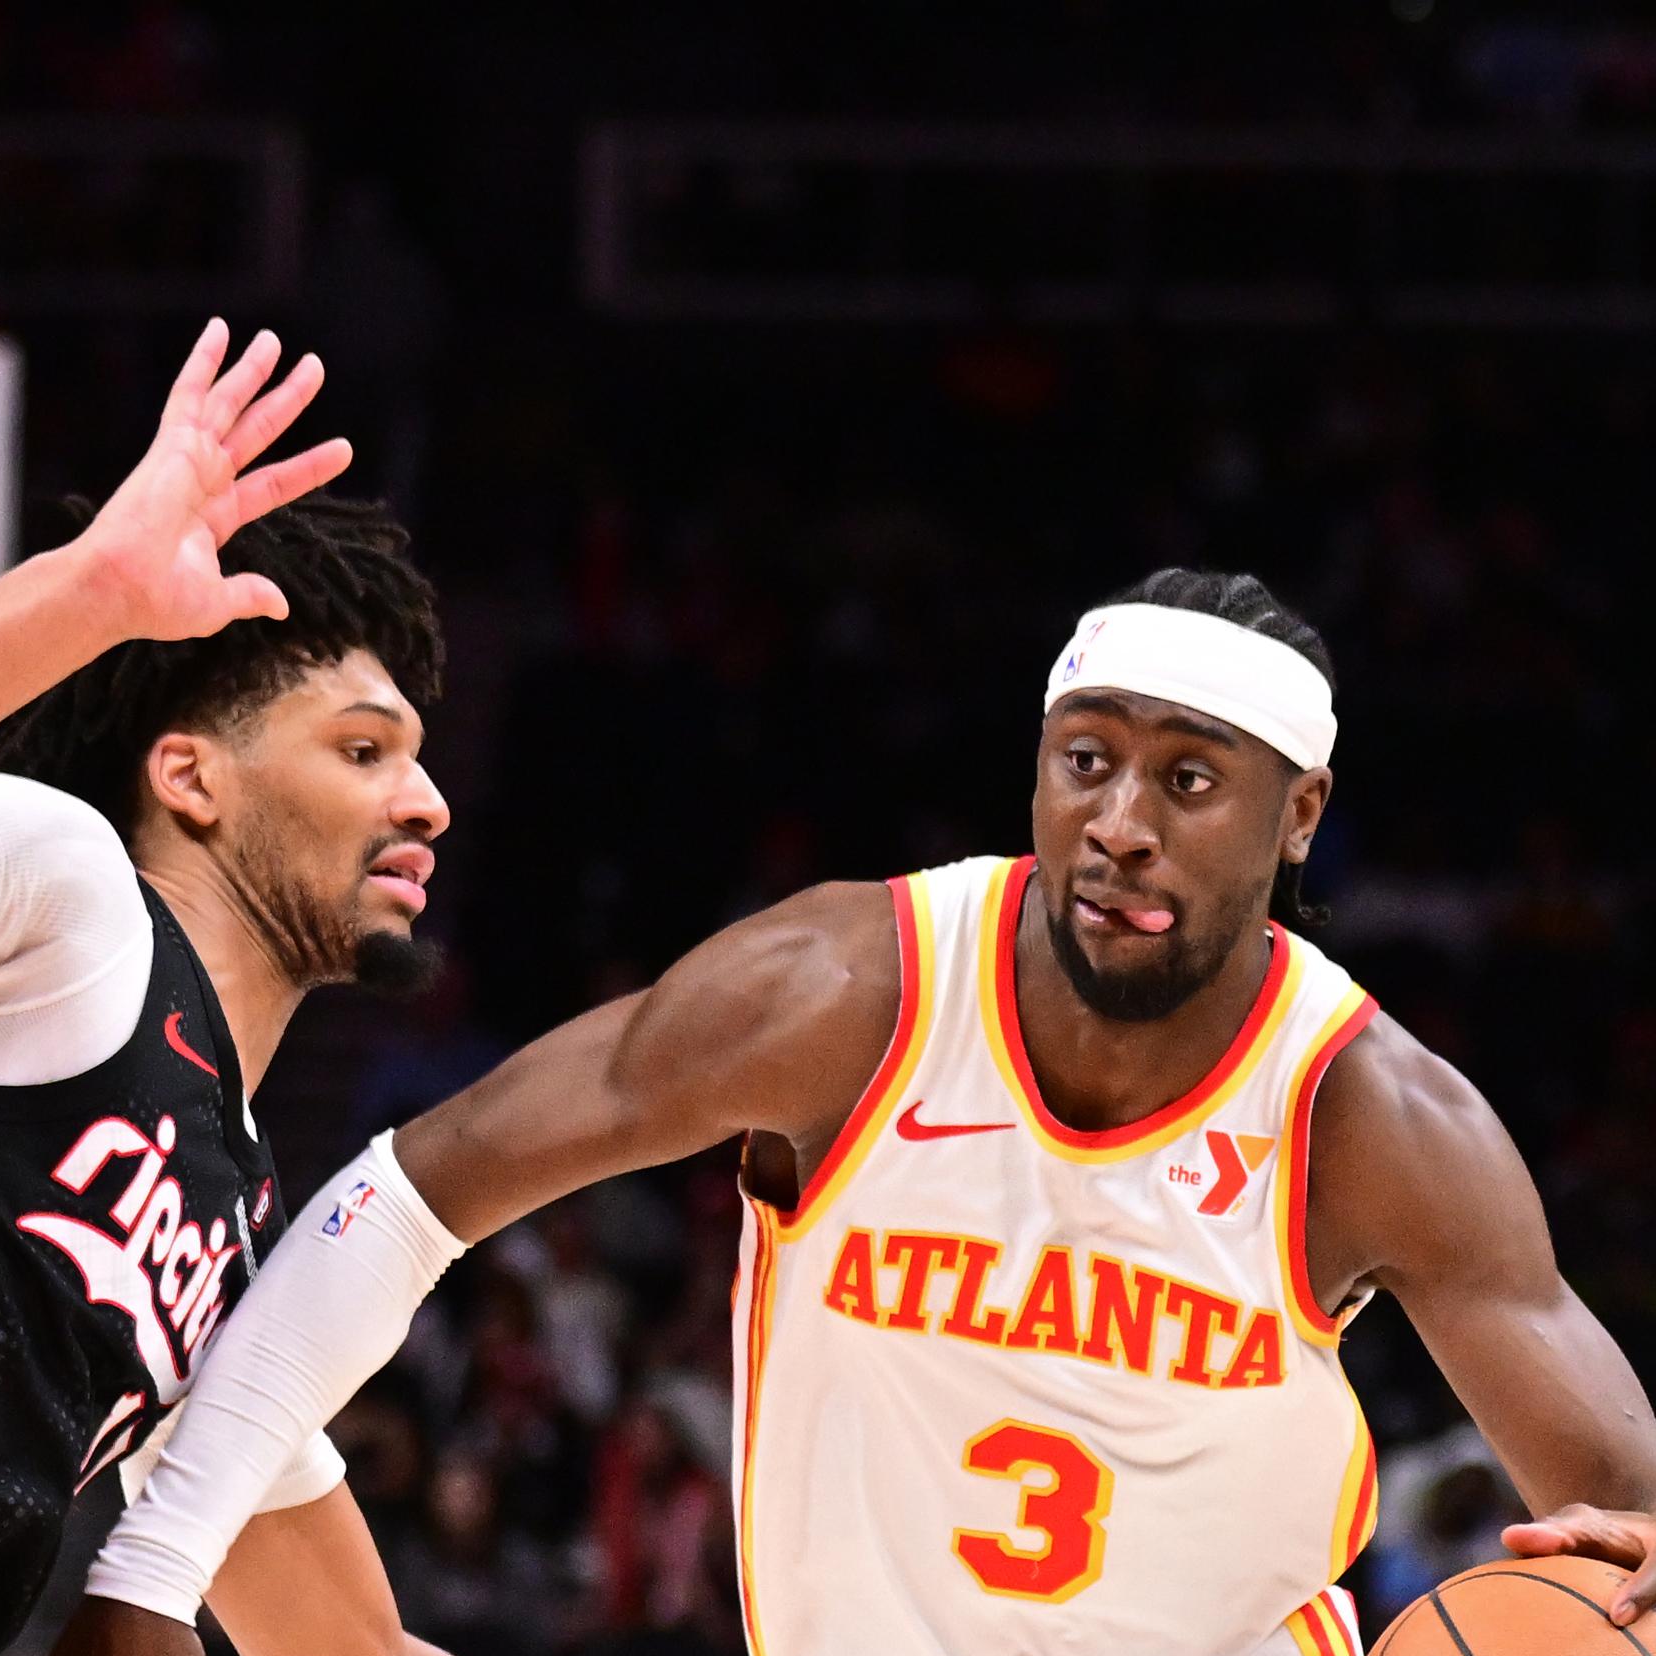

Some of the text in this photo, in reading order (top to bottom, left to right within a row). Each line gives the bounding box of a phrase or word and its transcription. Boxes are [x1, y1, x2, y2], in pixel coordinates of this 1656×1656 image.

[1168, 1164, 1202, 1186] the
[823, 1224, 1288, 1391] ATLANTA
[951, 1417, 1115, 1605] 3
